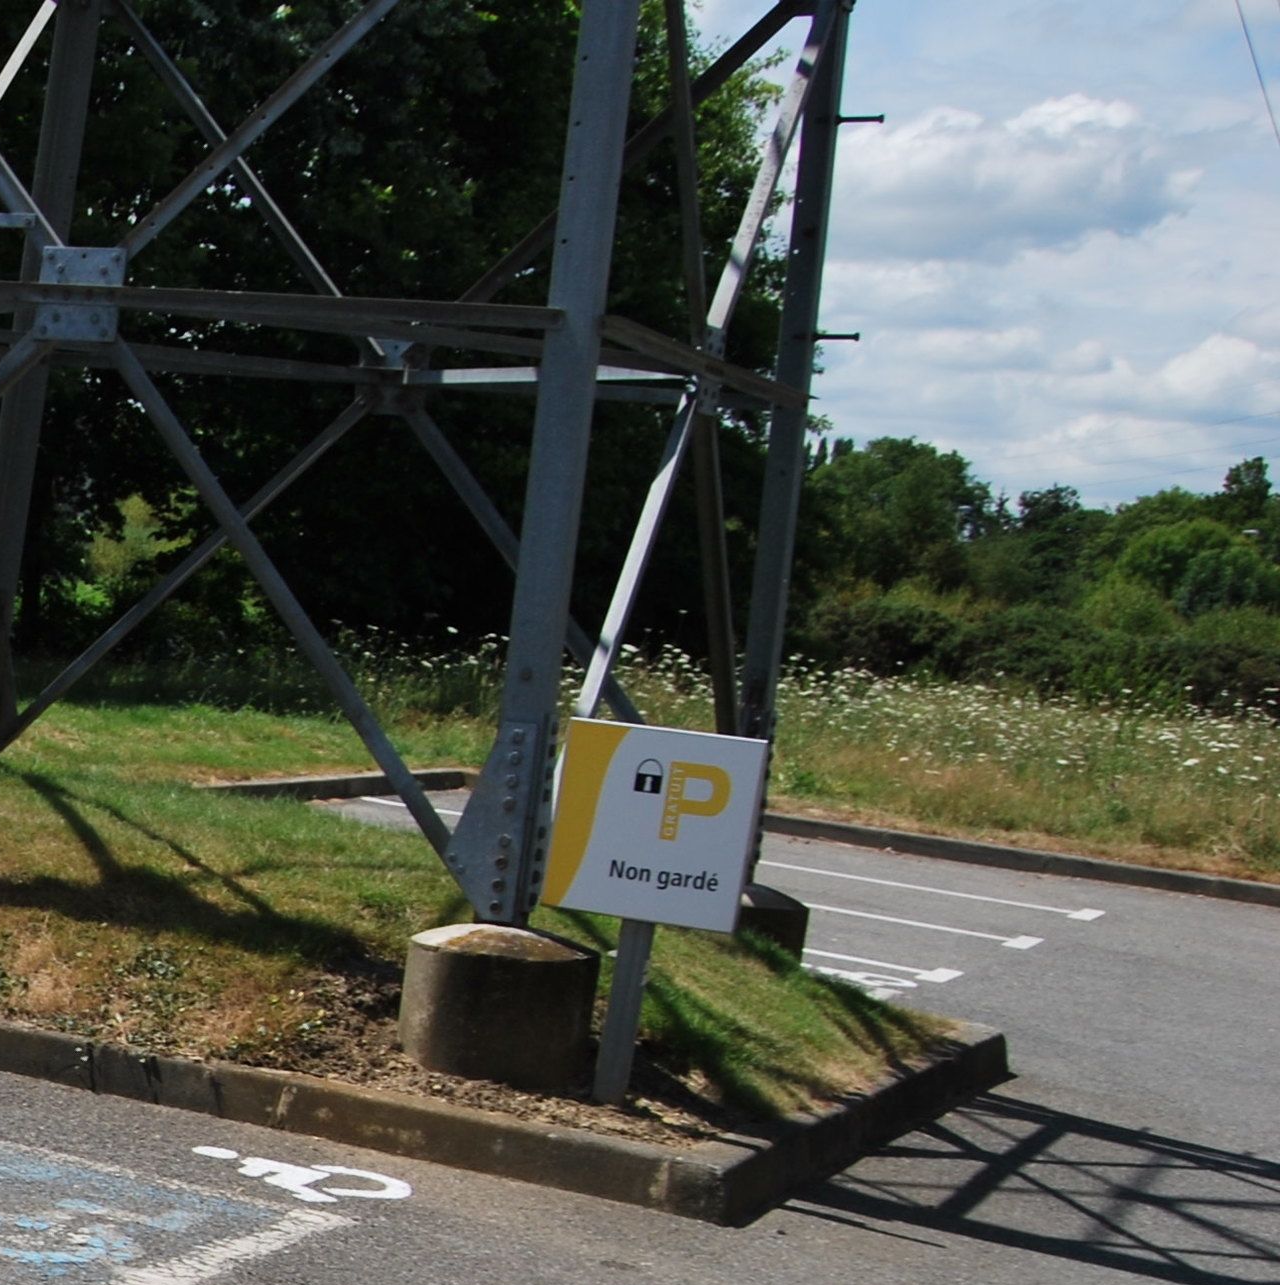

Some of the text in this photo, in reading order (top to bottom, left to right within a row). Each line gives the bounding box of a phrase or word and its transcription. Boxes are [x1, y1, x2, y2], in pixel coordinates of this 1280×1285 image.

[663, 768, 685, 837] GRATUIT
[609, 859, 720, 892] Non gardé
